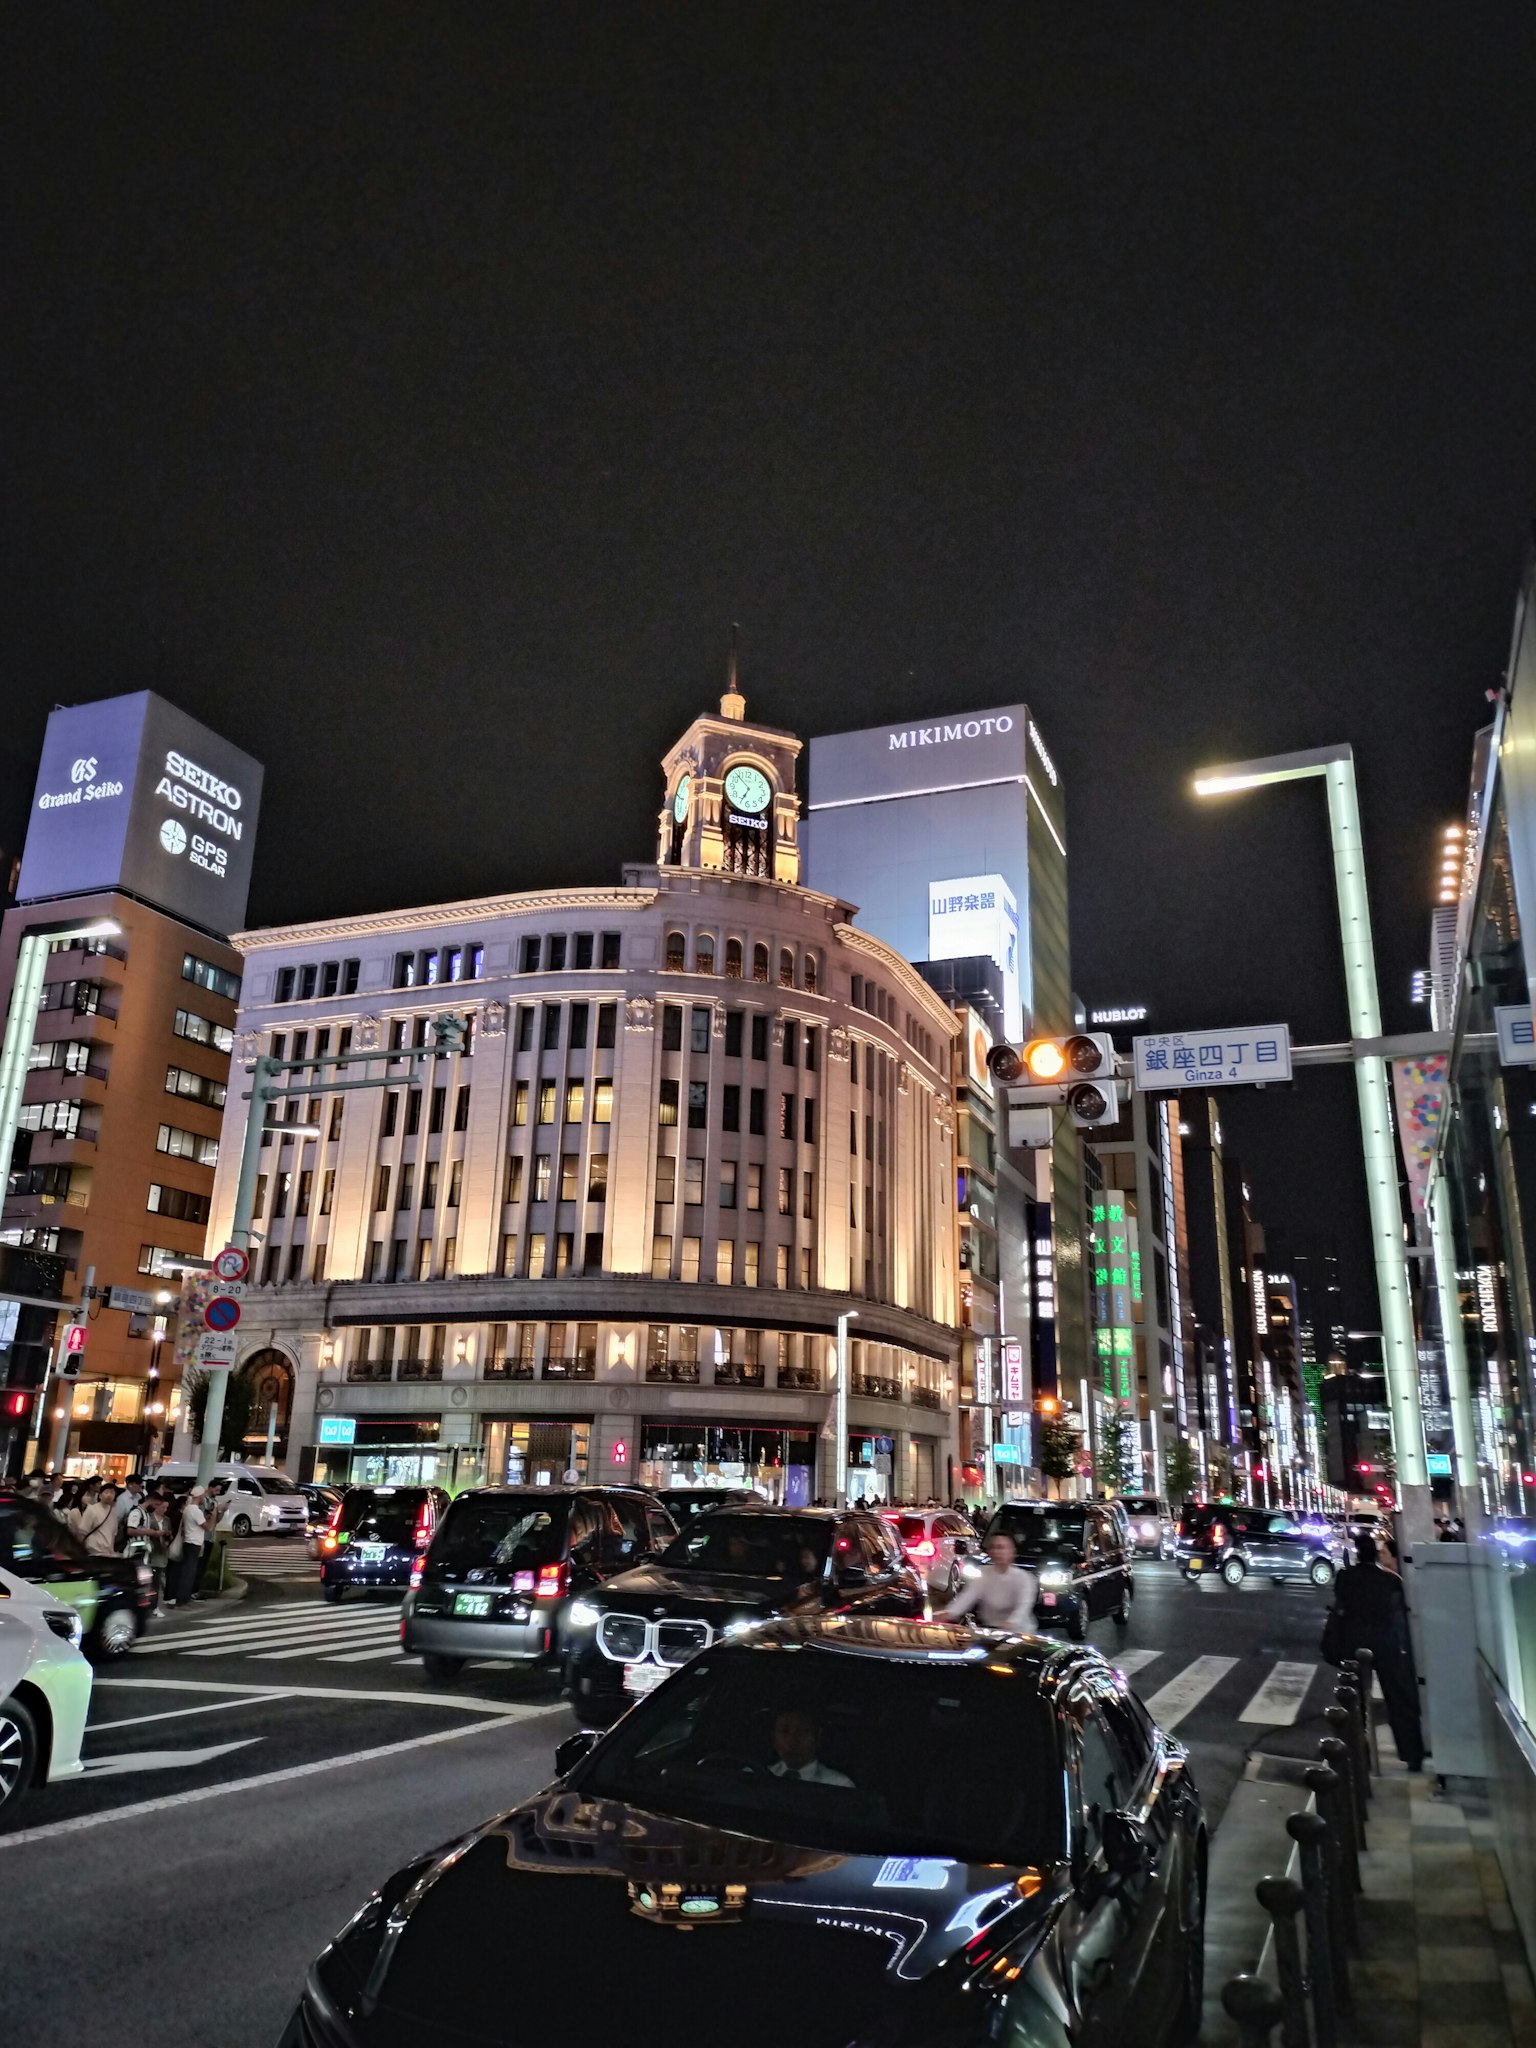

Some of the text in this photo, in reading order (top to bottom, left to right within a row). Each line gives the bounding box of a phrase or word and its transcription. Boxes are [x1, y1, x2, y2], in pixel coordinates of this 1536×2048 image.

[888, 716, 1013, 750] MIKIMOTO
[71, 756, 98, 784] GS
[165, 751, 242, 811] SEIKO
[38, 781, 123, 810] Grand Seiko
[154, 777, 243, 841] ASTRON
[729, 814, 768, 830] SEIKO
[191, 834, 228, 866] GPS
[189, 852, 226, 878] SOLAR
[932, 892, 996, 915] 山野楽器
[1092, 1007, 1147, 1023] HUBLOT
[1144, 1036, 1185, 1047] 中央区
[1145, 1041, 1278, 1071] 銀座四丁目
[1185, 1067, 1238, 1082] Ginza 4
[213, 1285, 241, 1294] 8-20
[1010, 1366, 1020, 1399] キムラヤ
